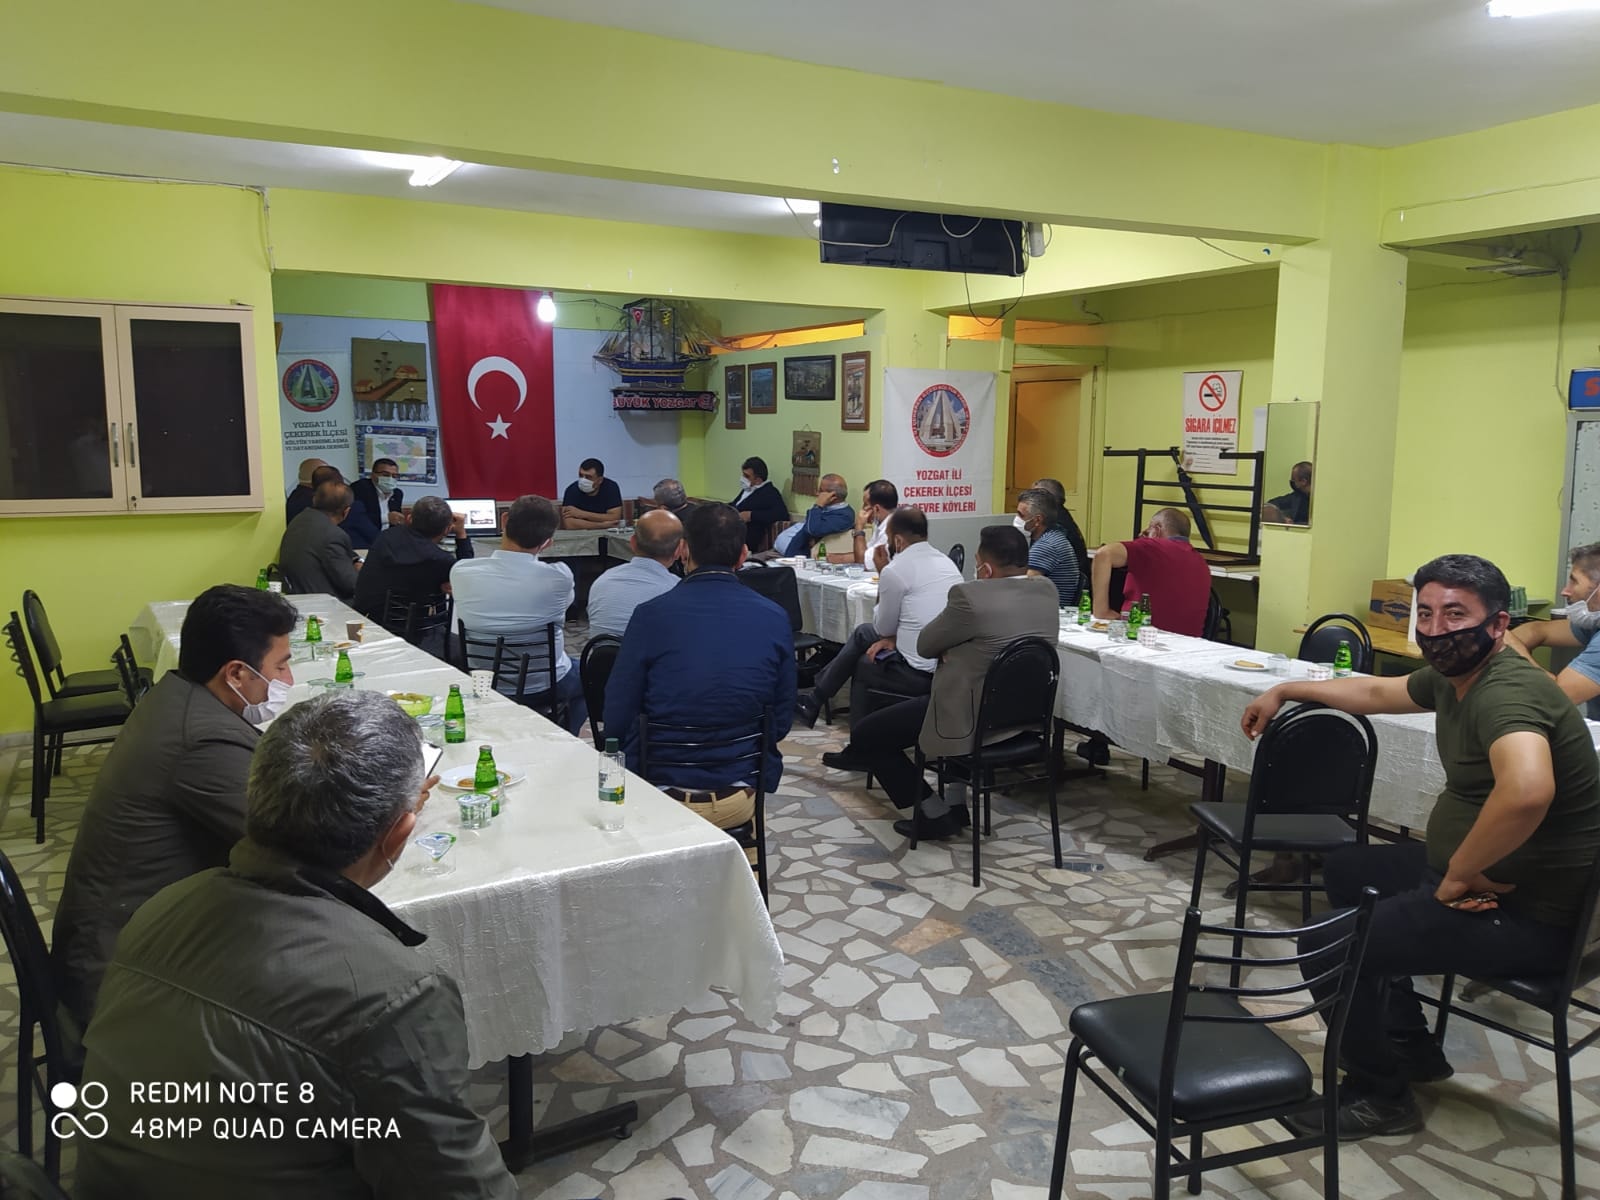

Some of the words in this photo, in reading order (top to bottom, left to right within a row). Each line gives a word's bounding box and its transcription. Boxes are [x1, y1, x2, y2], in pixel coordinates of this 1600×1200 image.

[1185, 414, 1211, 433] SİGARA
[916, 469, 950, 480] YOZGAT
[951, 467, 962, 480] İLİ
[904, 486, 944, 498] ÇEKEREK
[946, 484, 973, 497] İLÇESİ
[942, 500, 977, 513] KÖYLERİ
